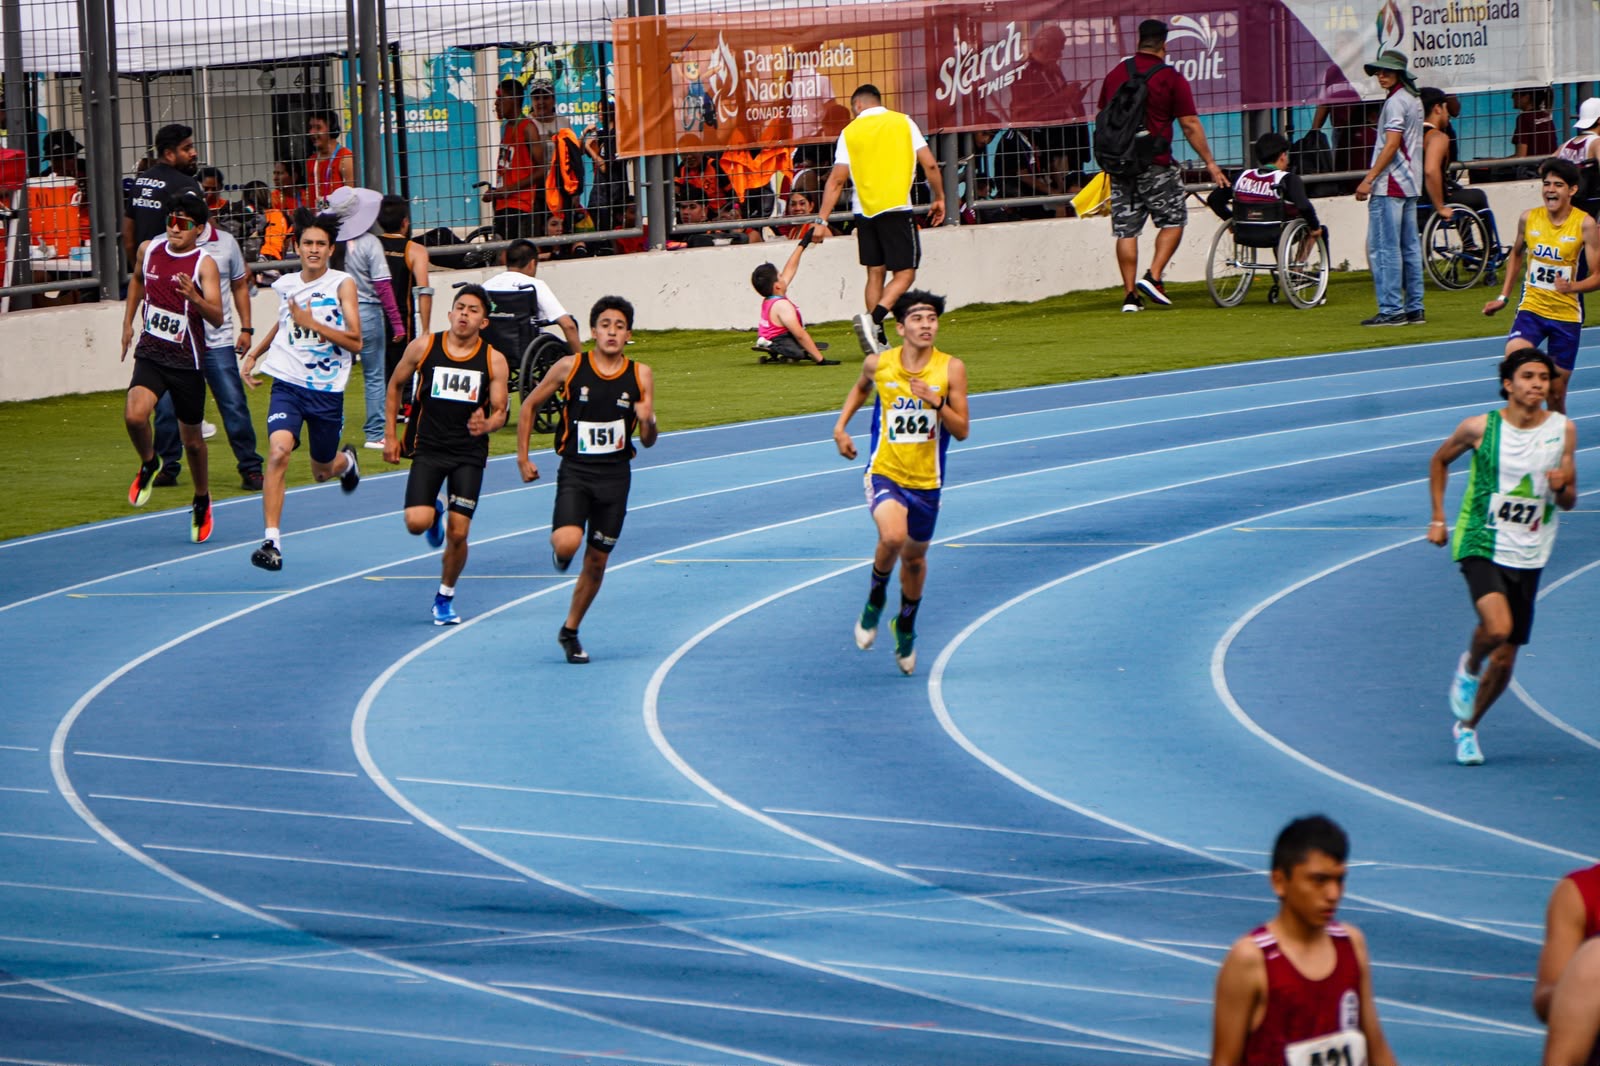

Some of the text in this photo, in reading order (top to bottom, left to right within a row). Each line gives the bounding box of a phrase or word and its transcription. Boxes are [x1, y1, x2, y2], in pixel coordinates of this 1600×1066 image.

[1411, 0, 1520, 26] Paralimpiada
[1412, 25, 1488, 51] Nacional
[743, 42, 855, 74] Paralimpiada
[1413, 53, 1476, 68] CONADE 2026
[745, 72, 822, 102] Nacional
[977, 64, 1026, 99] TWIST
[746, 105, 808, 121] CONADE 2026
[135, 177, 166, 189] ESTADO
[141, 188, 153, 197] DE
[132, 196, 162, 209] MÉXICO
[1533, 244, 1563, 260] JAL
[151, 312, 181, 335] 488
[442, 373, 472, 394] 144
[894, 415, 930, 434] 262
[588, 427, 615, 446] 151
[1498, 502, 1538, 524] 427
